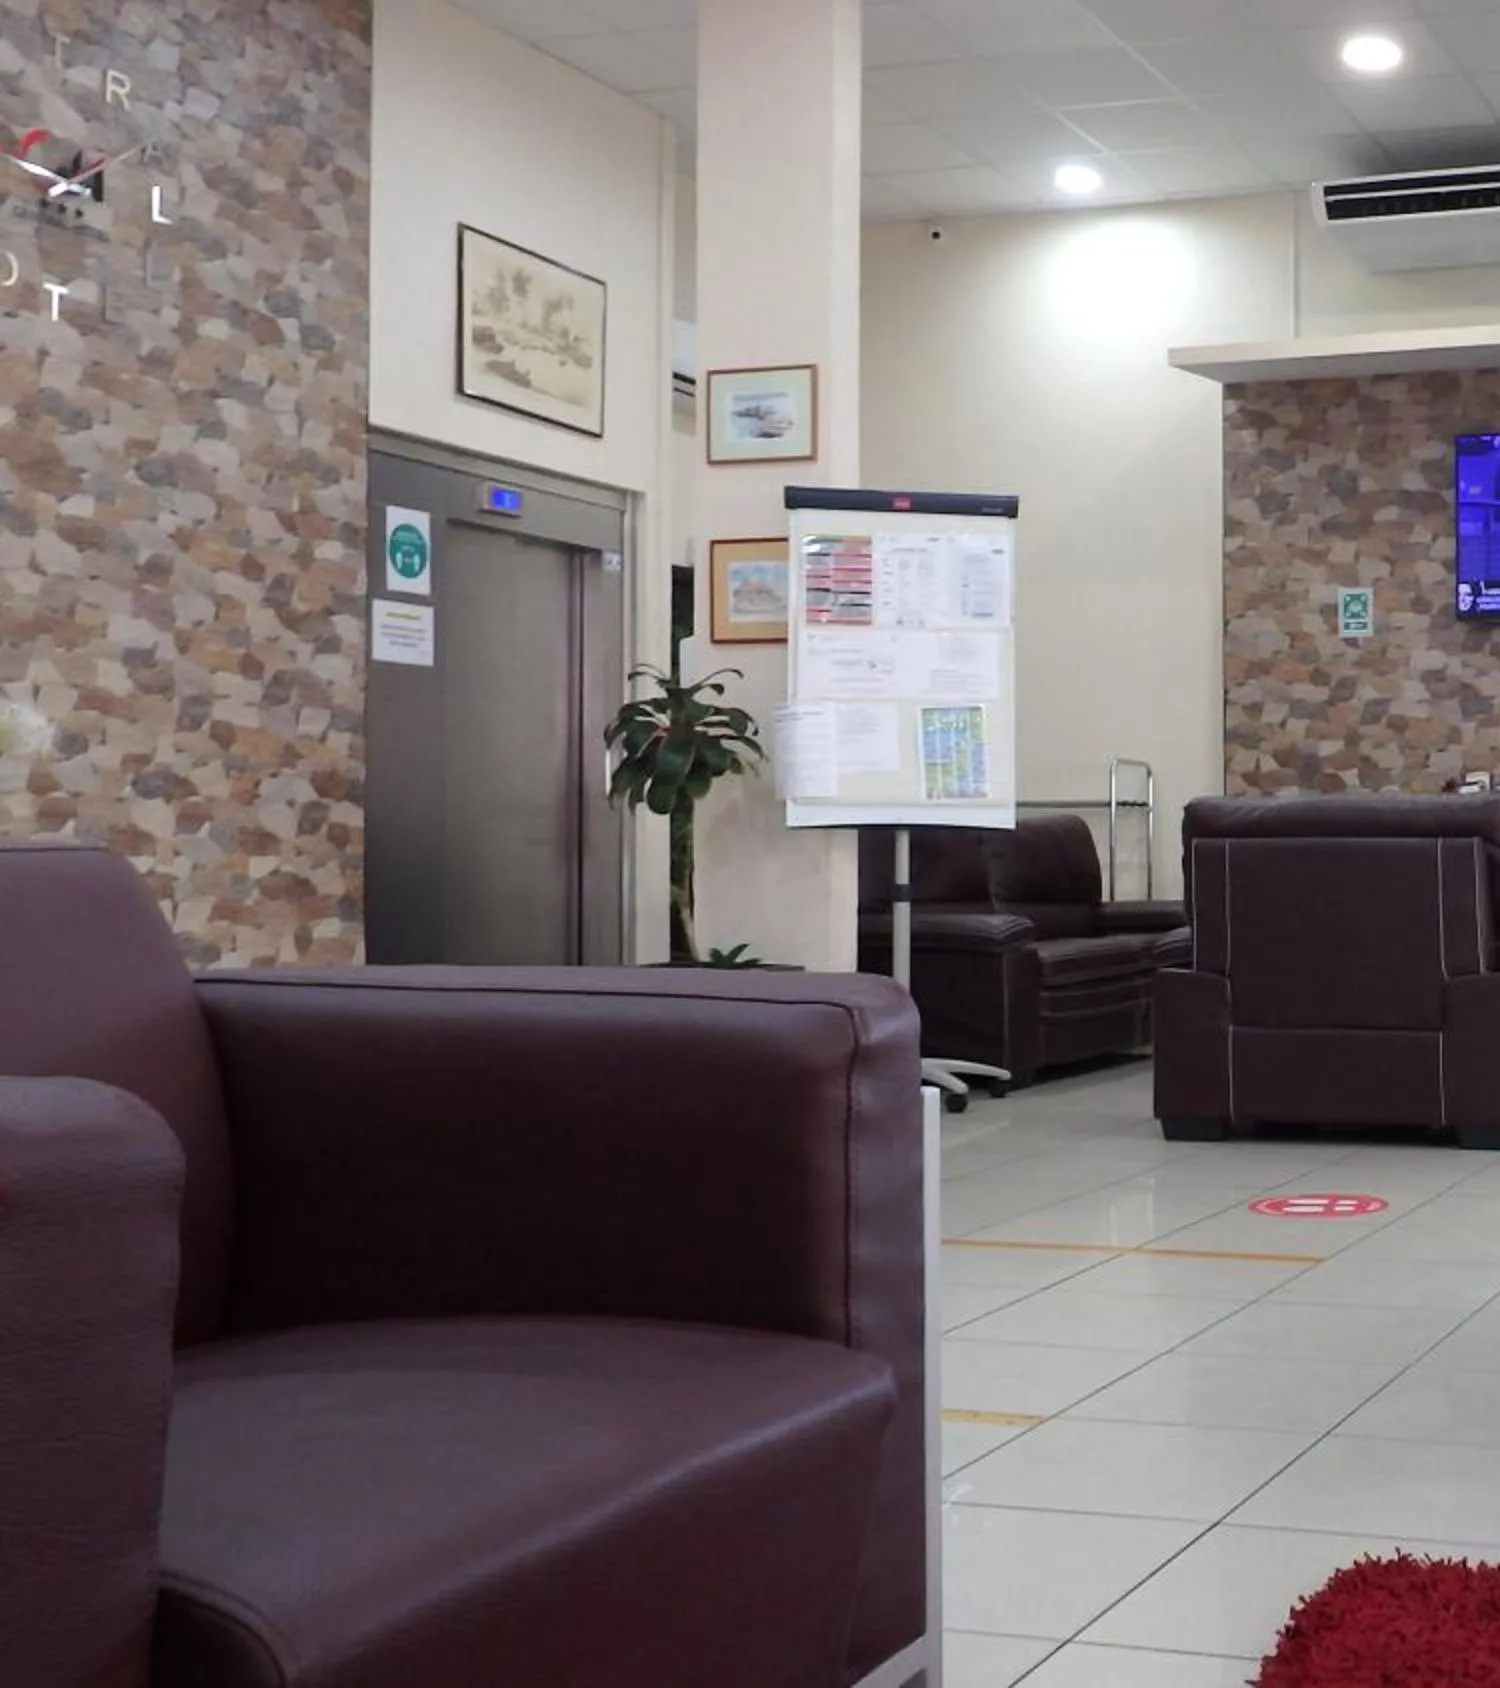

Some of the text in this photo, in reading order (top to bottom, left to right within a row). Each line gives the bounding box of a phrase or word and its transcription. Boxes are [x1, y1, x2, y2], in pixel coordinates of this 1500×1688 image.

[105, 69, 132, 111] R
[151, 185, 173, 225] L
[42, 282, 69, 322] T
